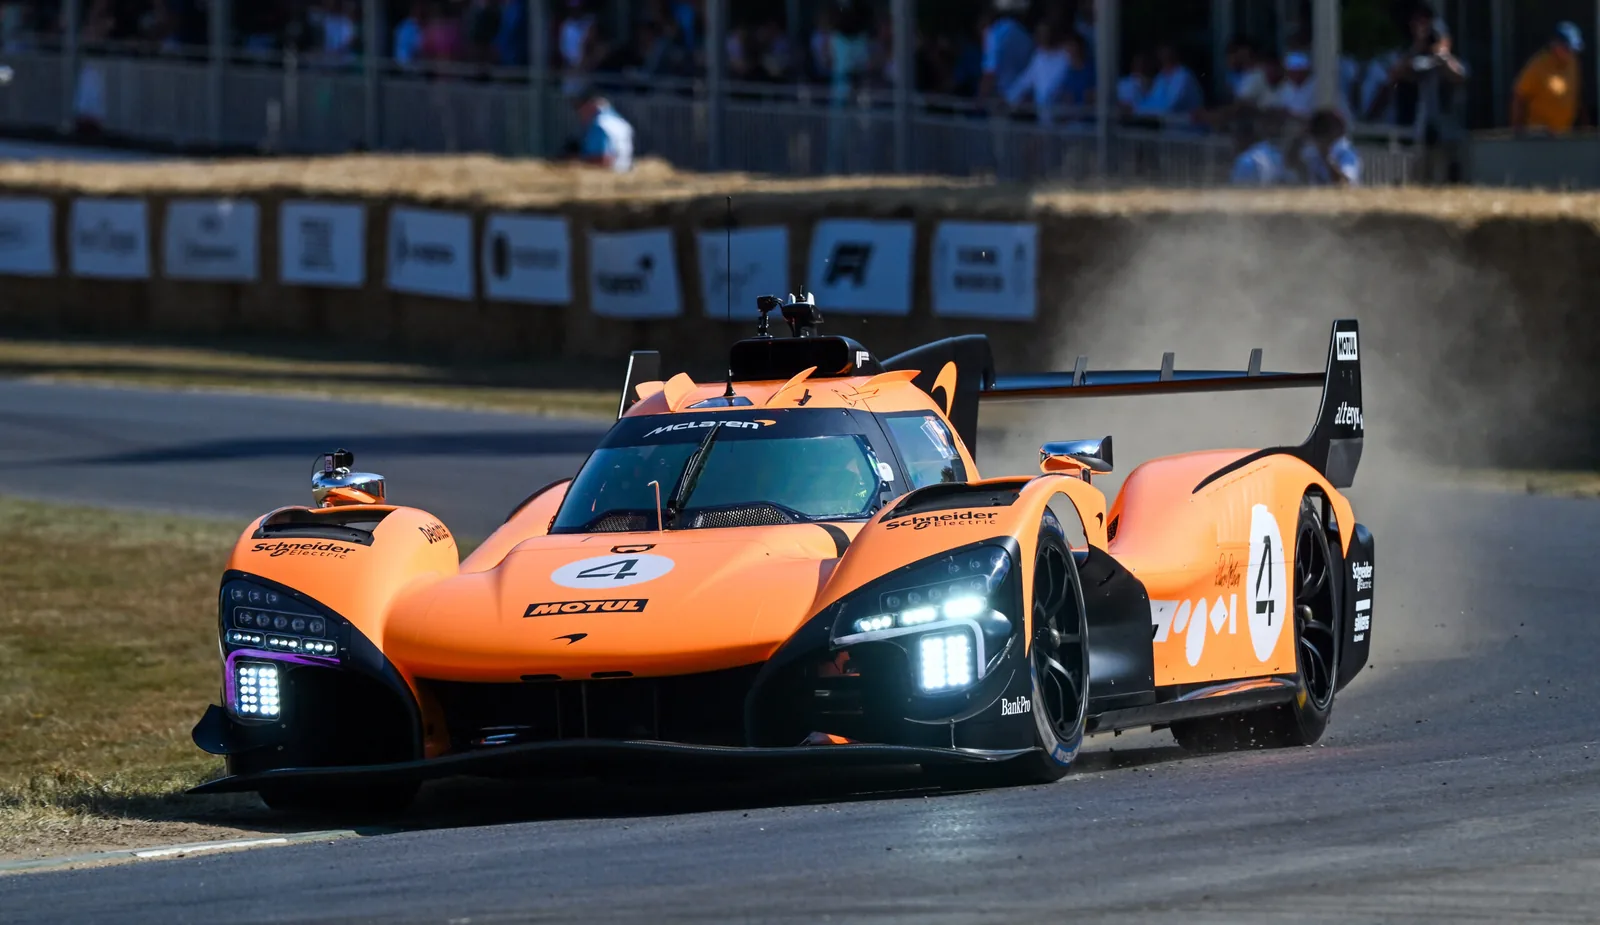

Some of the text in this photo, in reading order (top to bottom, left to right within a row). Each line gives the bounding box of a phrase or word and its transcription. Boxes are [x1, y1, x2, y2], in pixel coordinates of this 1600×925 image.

[1338, 336, 1356, 355] MOTUL
[886, 511, 999, 530] Schneider
[934, 519, 996, 527] Electric
[251, 541, 355, 555] Schneider
[289, 549, 347, 560] Electric
[576, 558, 639, 580] 4
[1256, 535, 1275, 627] 4
[529, 600, 640, 616] MOTUL
[1001, 695, 1031, 716] BankPro
